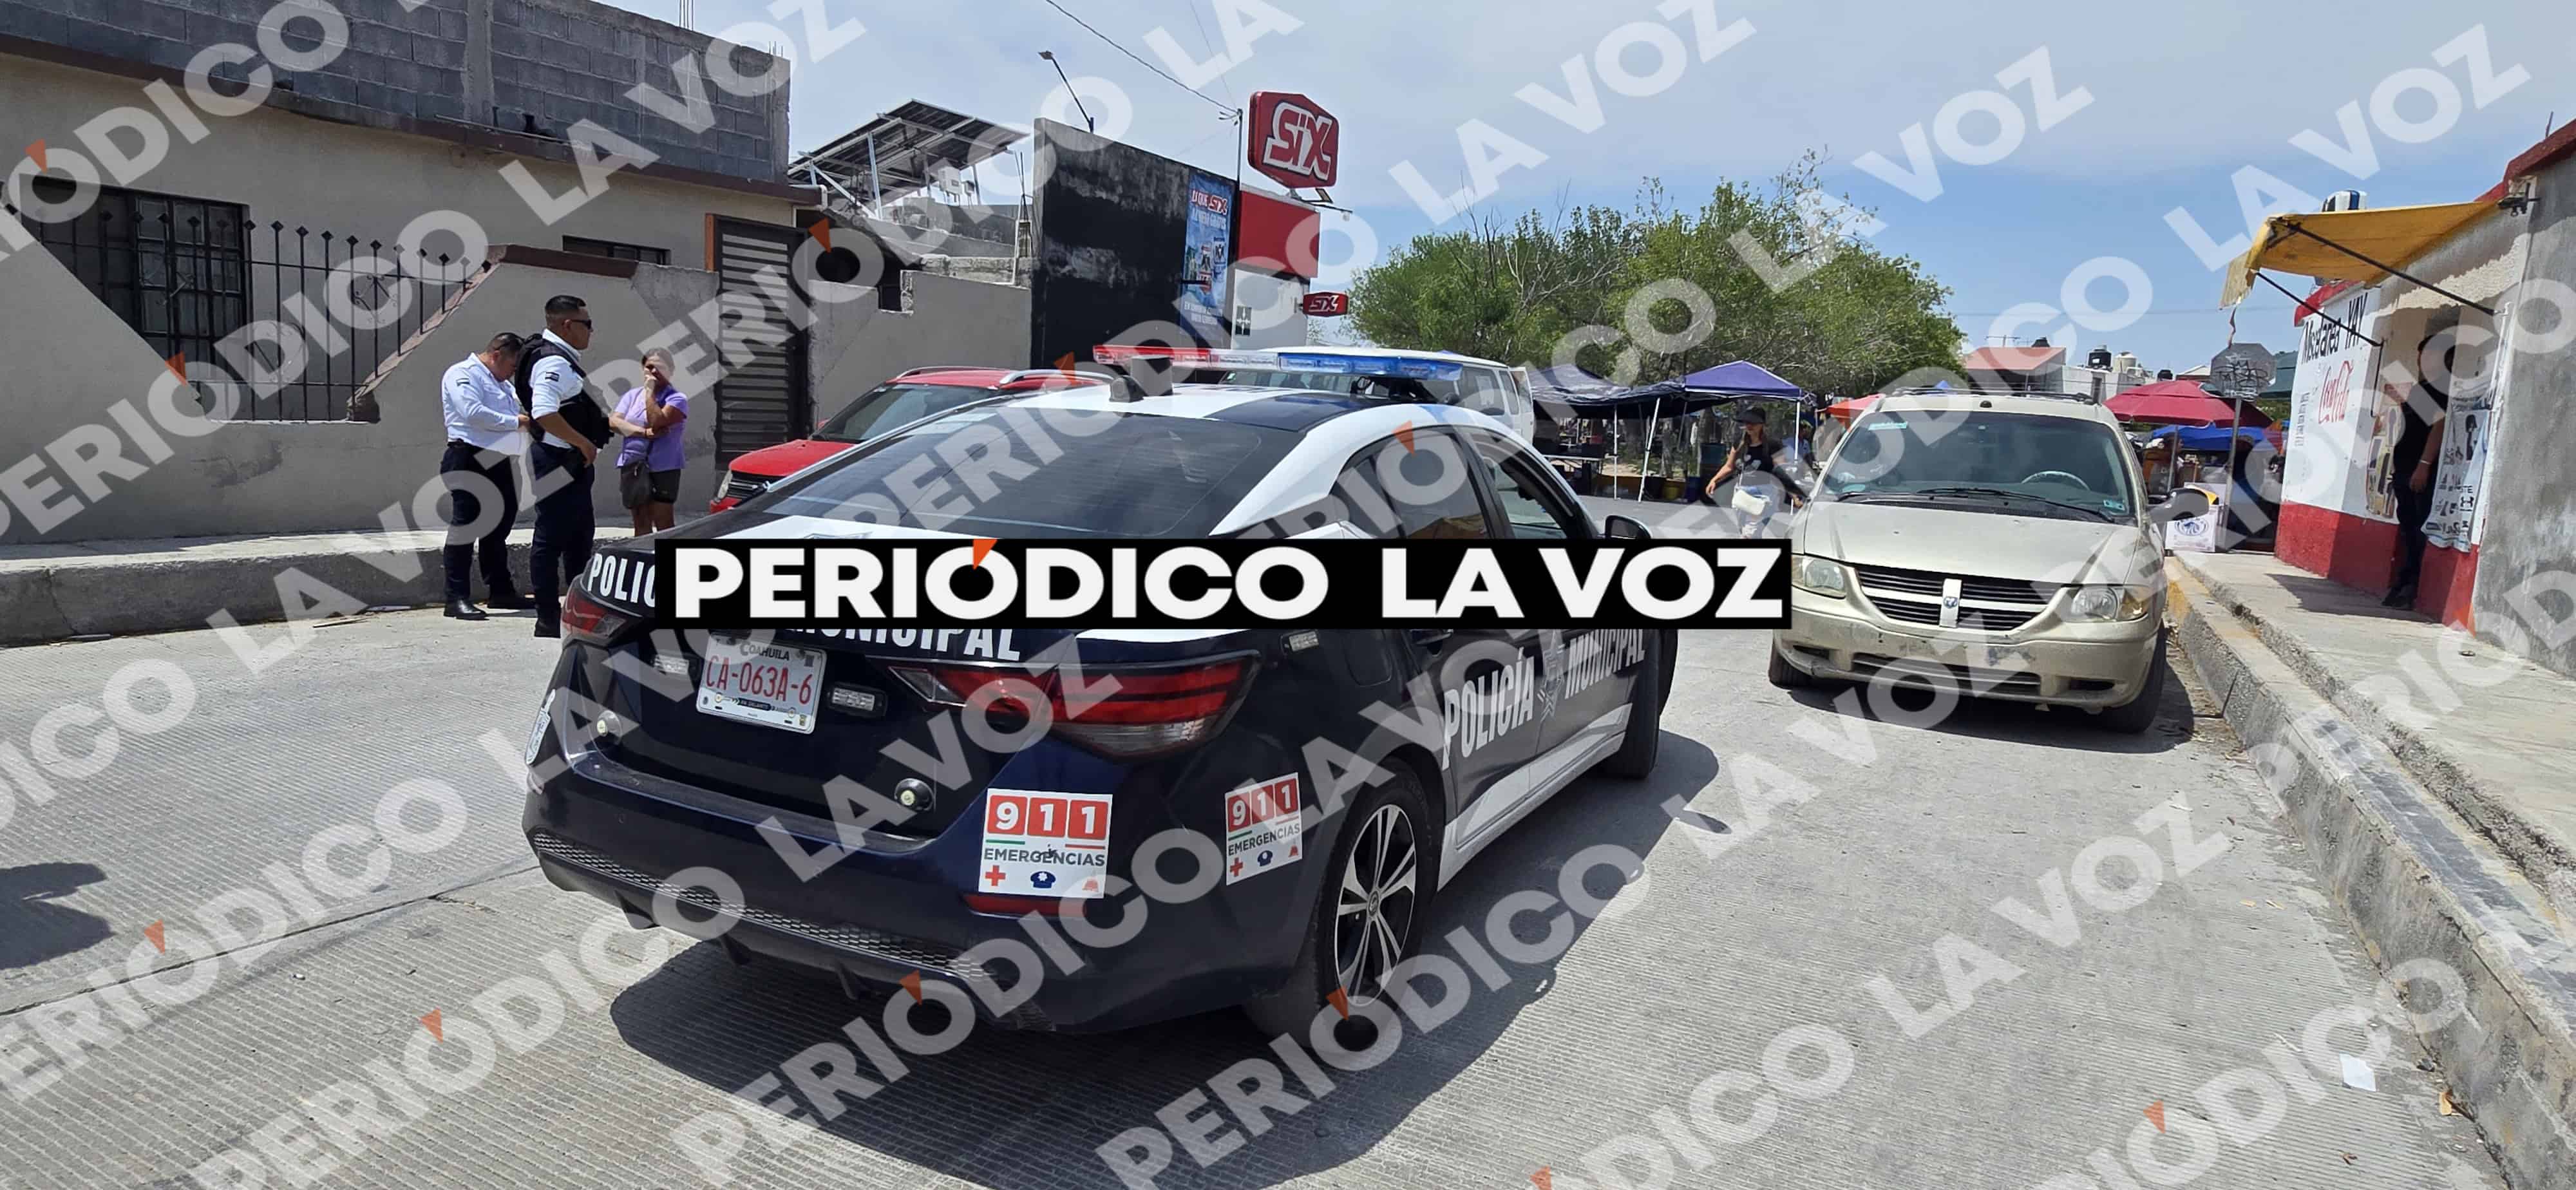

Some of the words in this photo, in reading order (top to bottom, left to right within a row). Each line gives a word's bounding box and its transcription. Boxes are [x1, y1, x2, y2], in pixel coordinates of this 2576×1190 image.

[741, 643, 790, 661] COAHUILA
[706, 655, 813, 705] CA-063A-6
[1442, 646, 1535, 771] POLICÍA
[1228, 823, 1300, 856] EMERGENCIAS
[983, 847, 1105, 867] EMERGENCIAS
